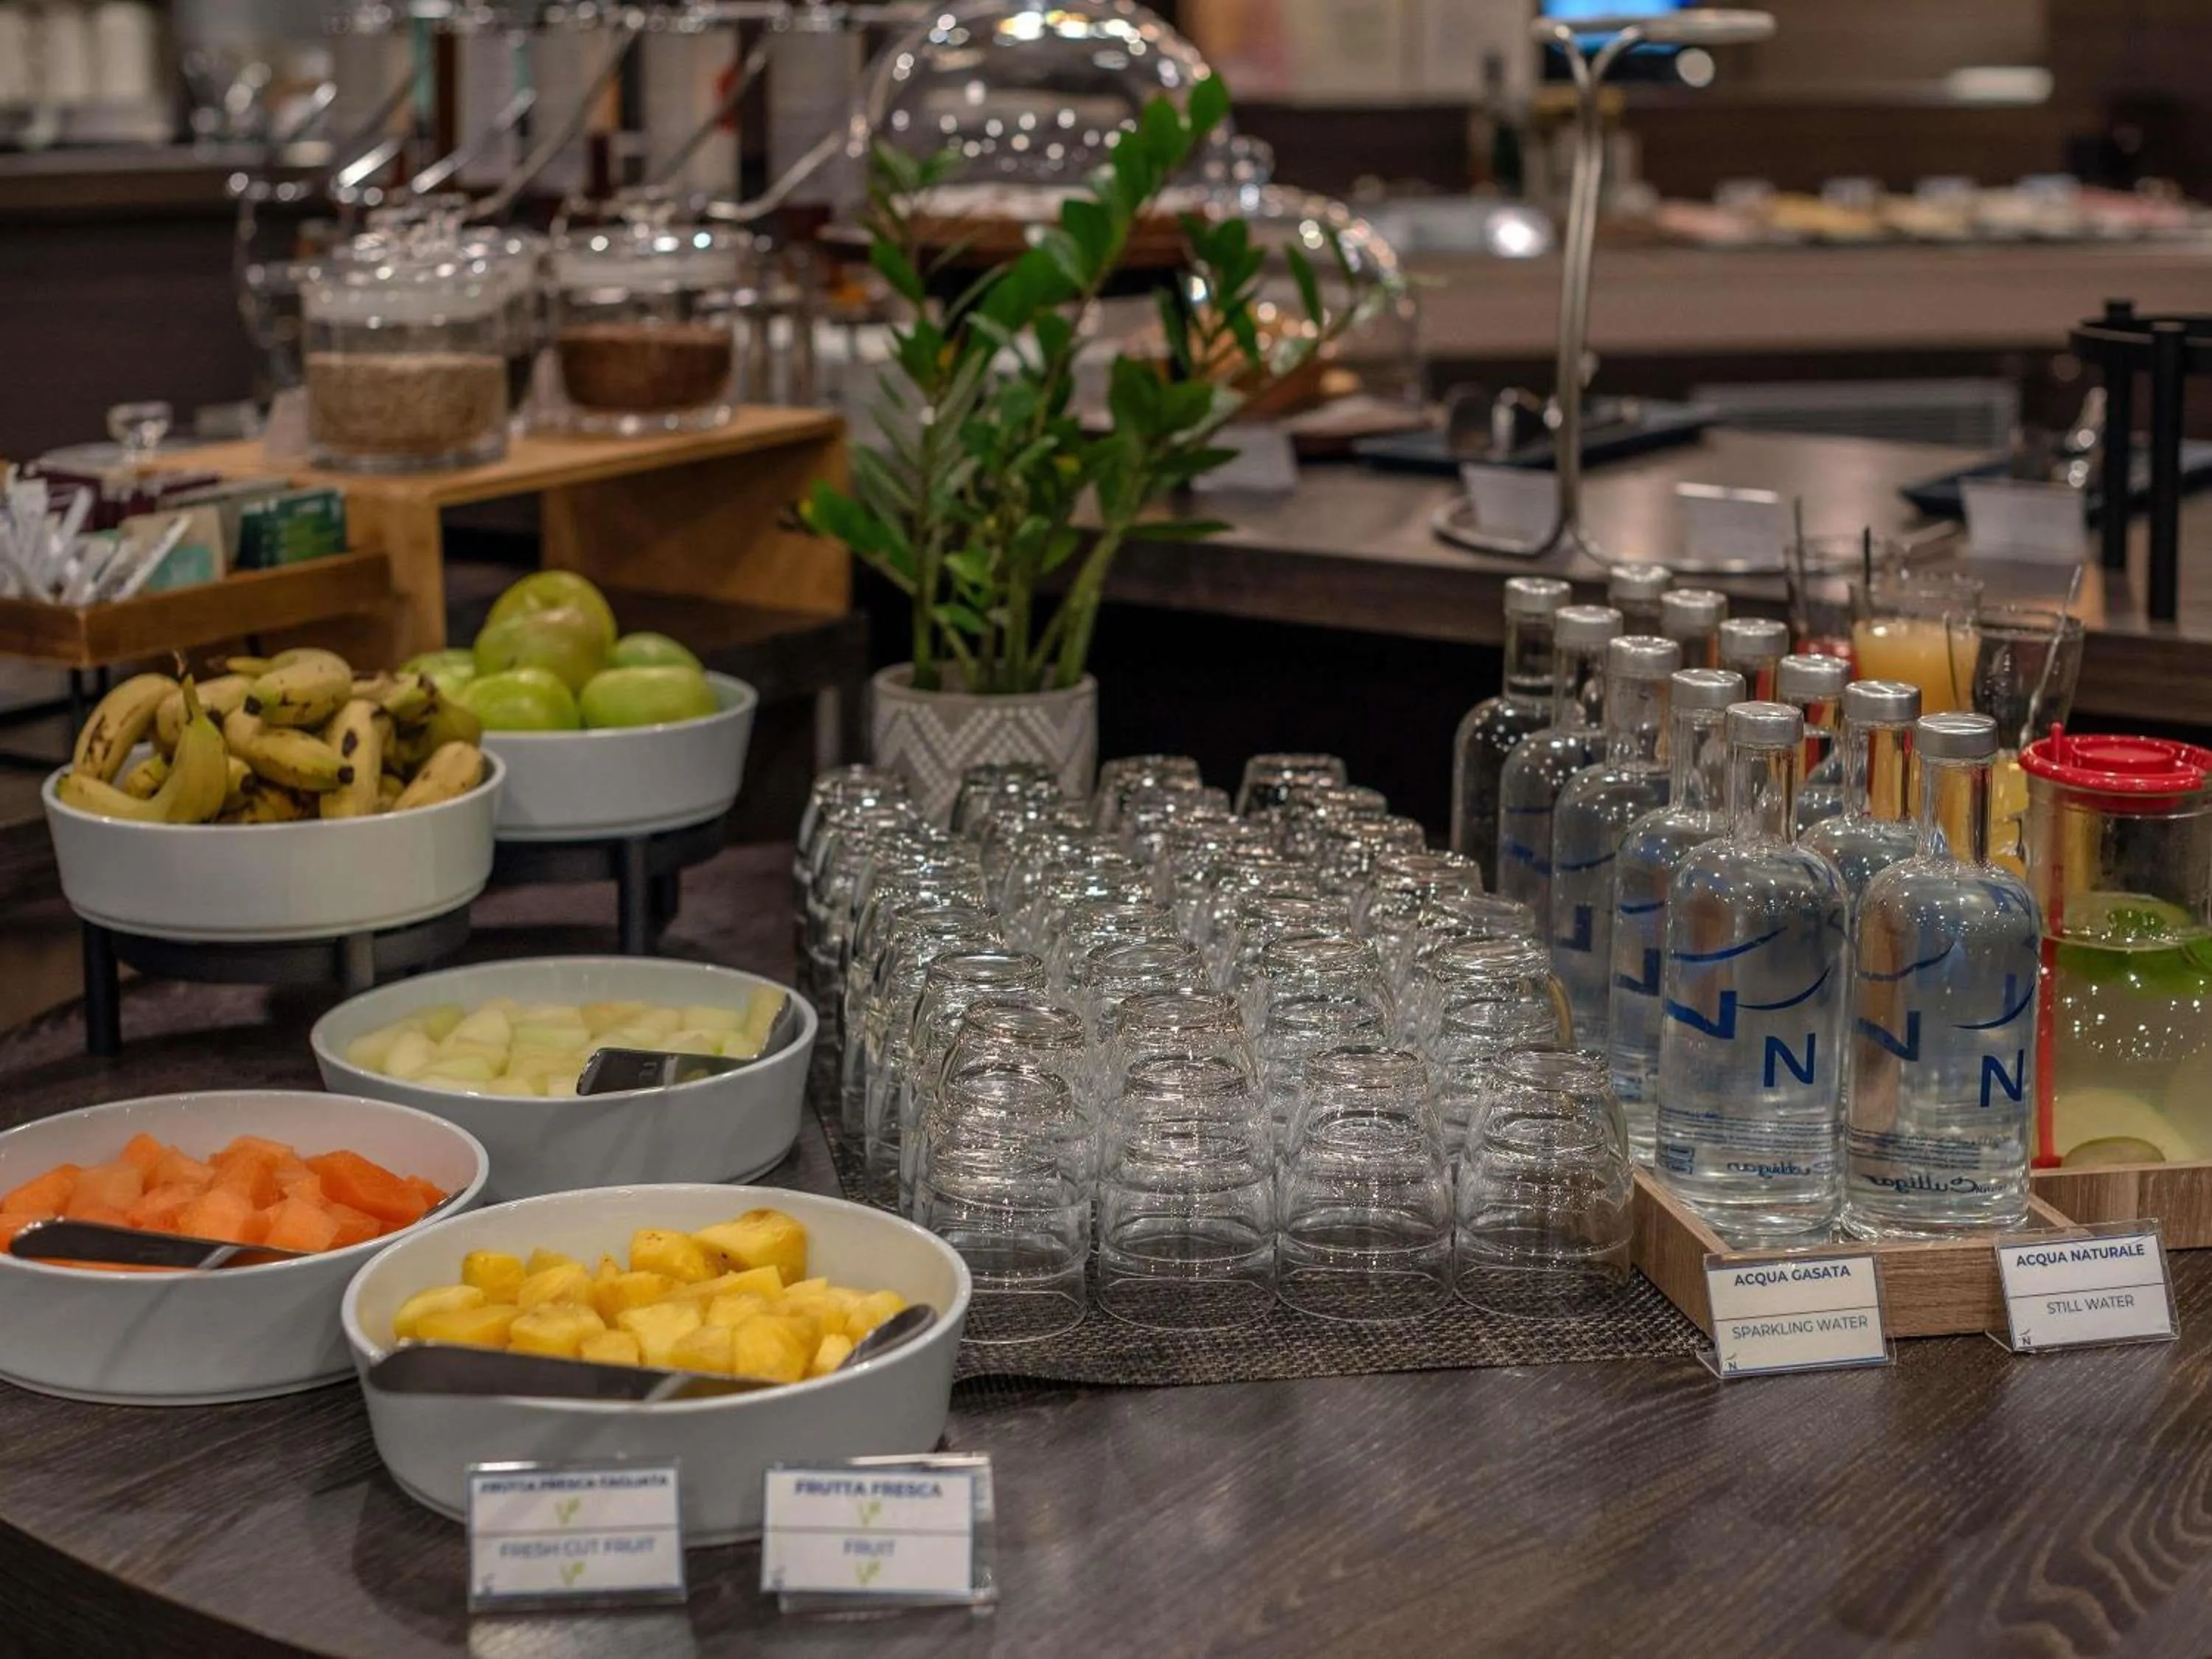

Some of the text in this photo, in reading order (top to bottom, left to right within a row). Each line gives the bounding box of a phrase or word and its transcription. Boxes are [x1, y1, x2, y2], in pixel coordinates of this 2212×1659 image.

[1763, 1032, 1816, 1088] N
[1979, 1048, 2025, 1107] N
[2017, 1244, 2145, 1267] ACQUA NATURALE
[1733, 1265, 1851, 1287] ACQUA GASATA
[2046, 1294, 2135, 1315] STILL WATER
[1731, 1315, 1868, 1340] SPARKLING WATER
[794, 1479, 943, 1498] FRUTTA FRESCA
[498, 1537, 657, 1558] FRESH CUT FRUIT
[843, 1538, 897, 1557] FRUIT
